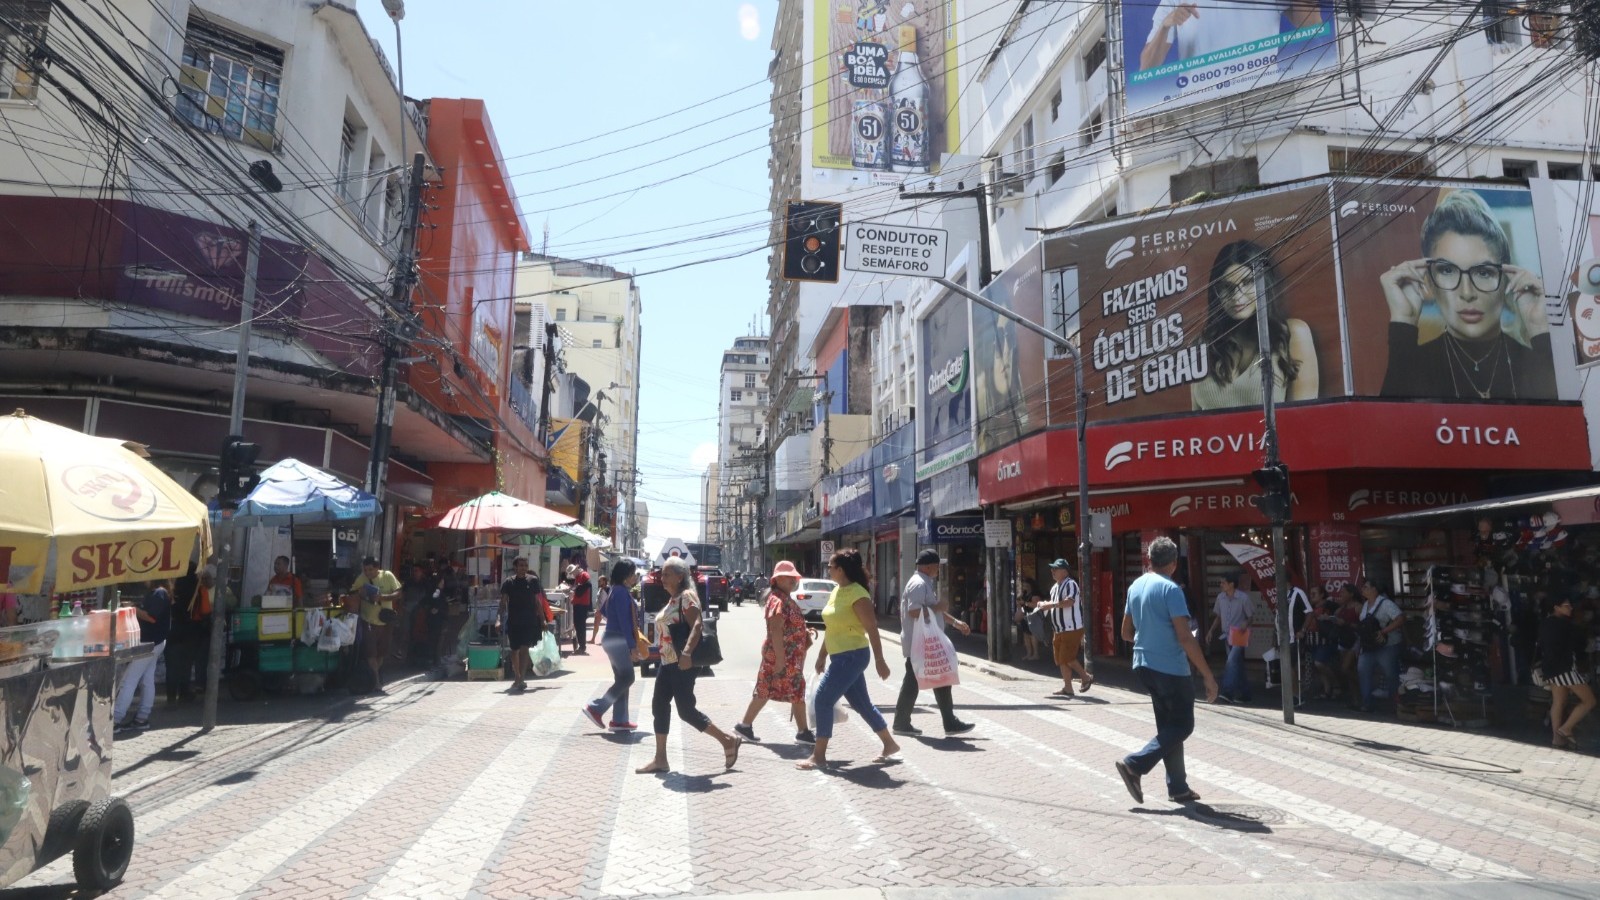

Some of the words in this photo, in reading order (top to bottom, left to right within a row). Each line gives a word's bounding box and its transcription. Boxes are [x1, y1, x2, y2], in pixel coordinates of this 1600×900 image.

[848, 54, 876, 67] BOA
[857, 46, 886, 58] UMA
[1133, 70, 1152, 82] FAÇA
[1155, 63, 1184, 76] AGORA
[1186, 58, 1205, 69] UMA
[1207, 44, 1256, 64] AVALIAÇÃO
[1258, 37, 1281, 51] AQUI
[1283, 26, 1325, 43] EMBAIXO
[1192, 67, 1220, 84] 0800
[1223, 63, 1245, 79] 790
[1247, 54, 1277, 72] 8080
[862, 119, 877, 141] 51
[901, 114, 915, 130] 51
[1361, 202, 1416, 213] FERROVIA
[856, 228, 938, 246] CONDUTOR
[1141, 218, 1237, 249] FERROVIA
[862, 244, 918, 258] RESPEITE
[922, 249, 931, 258] O
[862, 257, 929, 272] SEMÁFORO
[1103, 265, 1188, 316] FAZEMOS
[1128, 302, 1157, 325] SEUS
[1093, 313, 1184, 370] ÓCULOS
[1107, 364, 1136, 404] DE
[1142, 343, 1209, 394] GRAU
[1436, 418, 1520, 445] ÓTICA
[997, 460, 1021, 481] ÓTICA
[78, 472, 125, 498] SKOL
[1372, 490, 1469, 506] FERROVIA
[1332, 512, 1345, 520] 136
[72, 536, 181, 584] SKOL
[1249, 556, 1273, 570] Faça
[1319, 555, 1349, 563] GANHE
[1320, 563, 1350, 571] OUTRO
